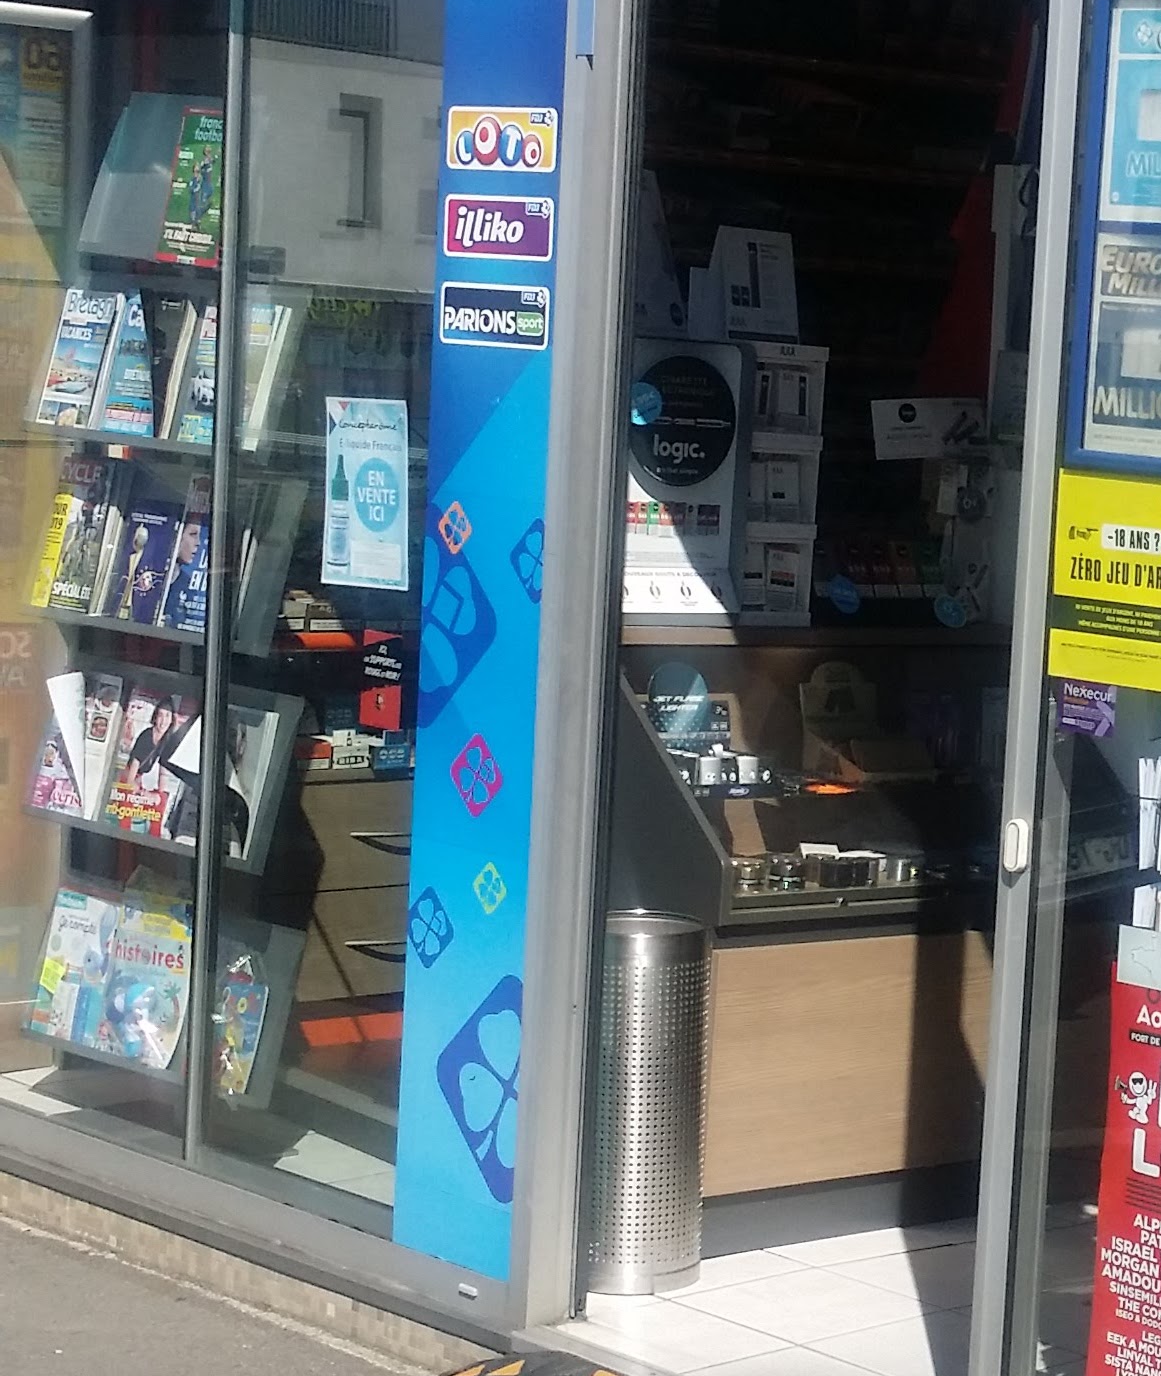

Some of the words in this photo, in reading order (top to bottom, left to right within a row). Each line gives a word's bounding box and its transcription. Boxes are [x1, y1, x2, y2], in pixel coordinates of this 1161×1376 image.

[455, 117, 541, 166] LOTO
[454, 204, 525, 248] illiko
[444, 306, 516, 335] PARIONS
[517, 314, 545, 331] sport
[653, 433, 706, 464] logic.
[368, 470, 385, 486] EN
[357, 488, 396, 505] VENTE
[368, 505, 384, 523] ICI
[1107, 529, 1126, 548] -18
[1129, 530, 1150, 551] ANS
[1154, 533, 1161, 552] ?
[1070, 553, 1101, 582] ZÉRO
[1106, 561, 1130, 586] JEU
[1130, 1032, 1149, 1044] FORT
[1150, 1036, 1160, 1046] DE
[1111, 1236, 1158, 1262] ISRAEL
[1101, 1247, 1160, 1278] MORGAN
[1101, 1264, 1161, 1293] AMADOU
[1115, 1308, 1134, 1321] ISEO
[1118, 1297, 1141, 1314] THE
[1106, 1331, 1128, 1347] EEK
[1104, 1353, 1133, 1372] SISTA
[1117, 1346, 1154, 1367] LINVAL
